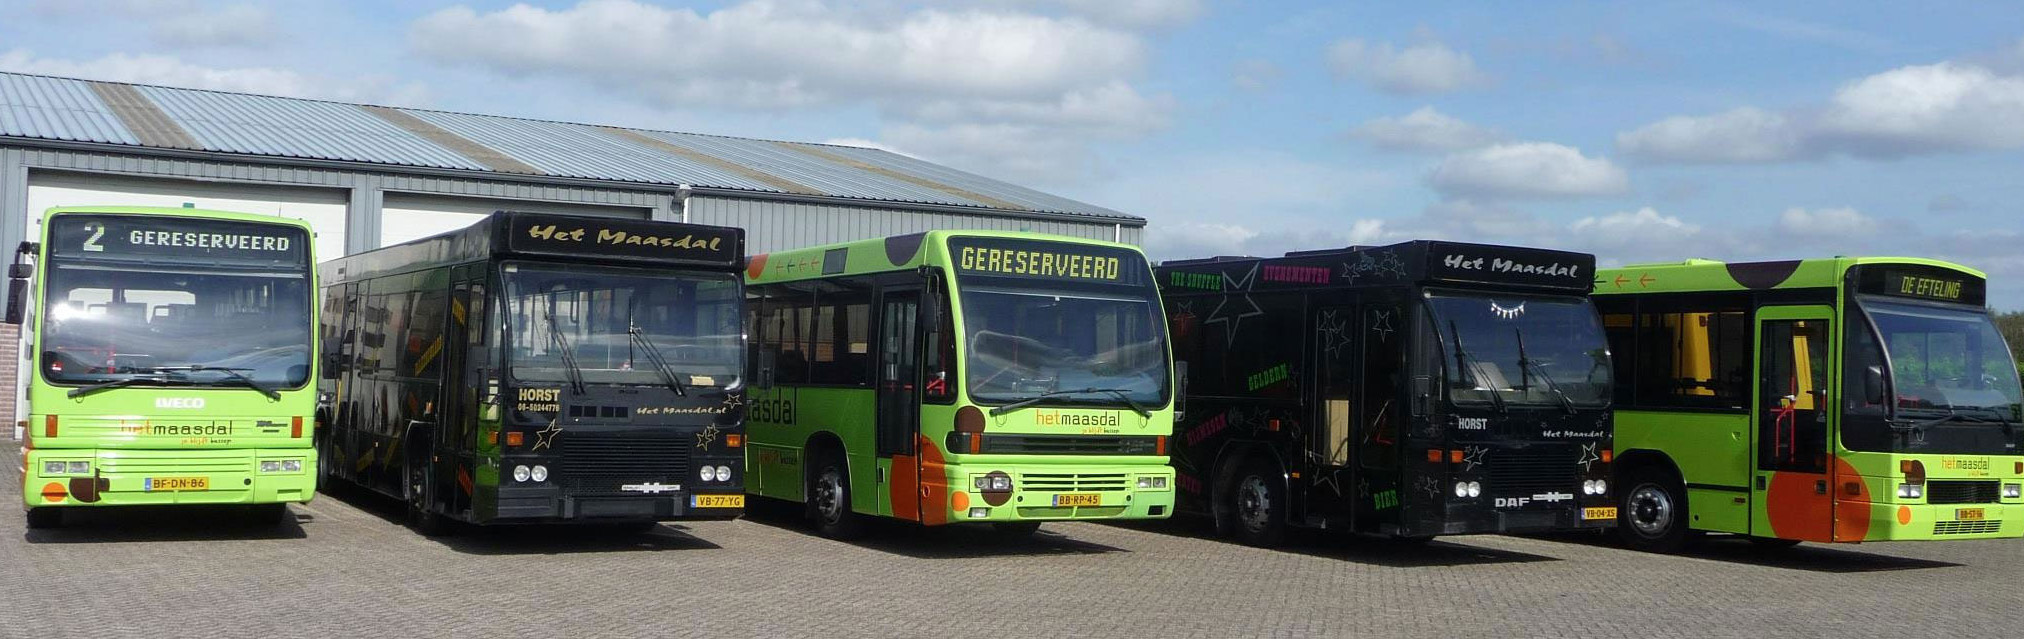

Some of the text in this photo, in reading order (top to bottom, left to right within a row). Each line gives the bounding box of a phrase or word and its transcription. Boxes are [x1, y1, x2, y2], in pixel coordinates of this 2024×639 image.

[83, 221, 290, 252] 2 GERESERVEERD
[529, 225, 720, 251] Het Maasdal
[961, 246, 1119, 280] GERESERVEERD
[1444, 254, 1578, 278] Het Maasdal
[1901, 276, 1961, 299] DE EFTELING
[518, 388, 560, 401] HORST
[155, 397, 205, 409] IVECO
[636, 407, 658, 415] Het
[1458, 418, 1488, 430] HORST
[1542, 430, 1561, 438] Het
[153, 479, 205, 489] BF-DN-86
[700, 496, 741, 506] VB-77-YG
[1059, 495, 1098, 505] BB-RP-45
[1374, 489, 1399, 511] BIER
[1494, 497, 1531, 508] DAF
[1586, 508, 1615, 518] VB-04-XS
